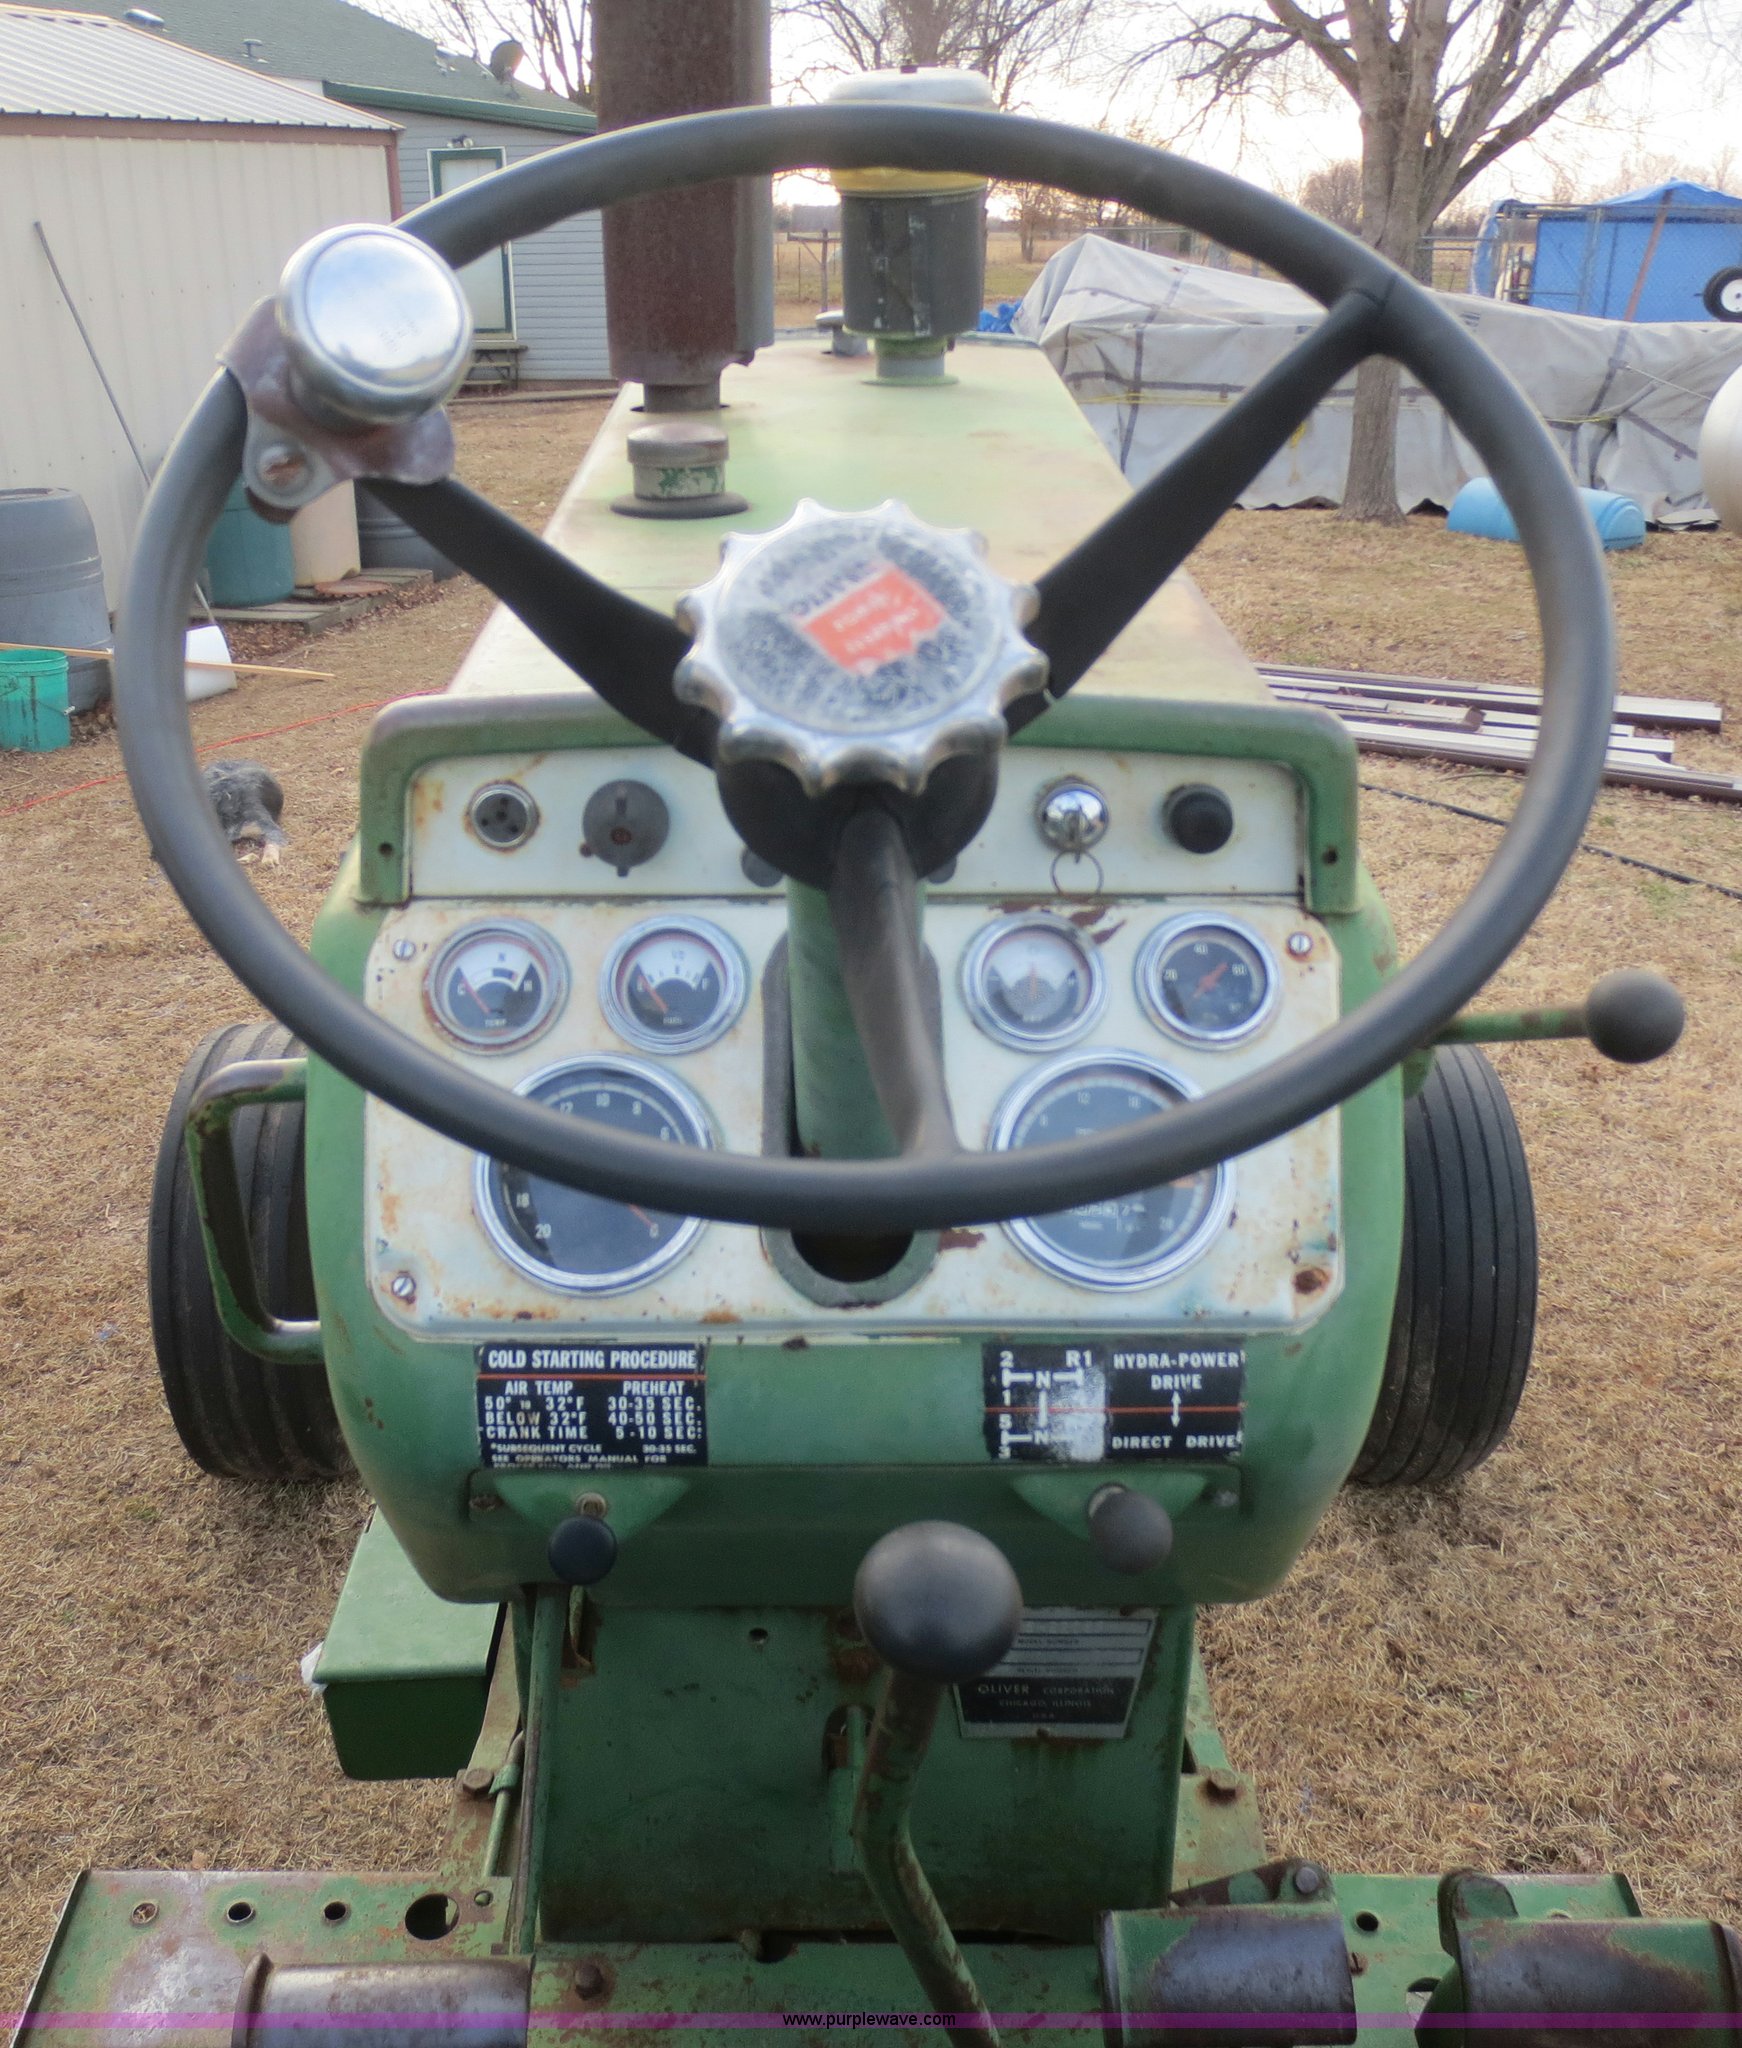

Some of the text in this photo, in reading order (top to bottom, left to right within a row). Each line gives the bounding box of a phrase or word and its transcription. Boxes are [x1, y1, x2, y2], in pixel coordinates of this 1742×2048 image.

[488, 1350, 696, 1369] COLD STARTING PROCEDURE
[1000, 1350, 1014, 1368] 2
[1113, 1352, 1239, 1370] HYDRA-POWER
[1035, 1370, 1051, 1389] N
[1151, 1373, 1203, 1390] DRIVE
[505, 1380, 574, 1395] AIR TEMP
[622, 1380, 685, 1395] PREHEAT
[608, 1396, 655, 1411] 30-35
[485, 1411, 541, 1425] BELOW
[608, 1411, 656, 1426] 40-50
[486, 1426, 588, 1439] CRANK TIME
[1034, 1429, 1049, 1445] N
[568, 1443, 602, 1454] CYCLE
[1112, 1434, 1235, 1449] DIRECT DRIVE
[588, 1454, 638, 1464] MANUAL
[644, 1454, 667, 1464] FOR
[977, 1683, 1030, 1695] OLIVER
